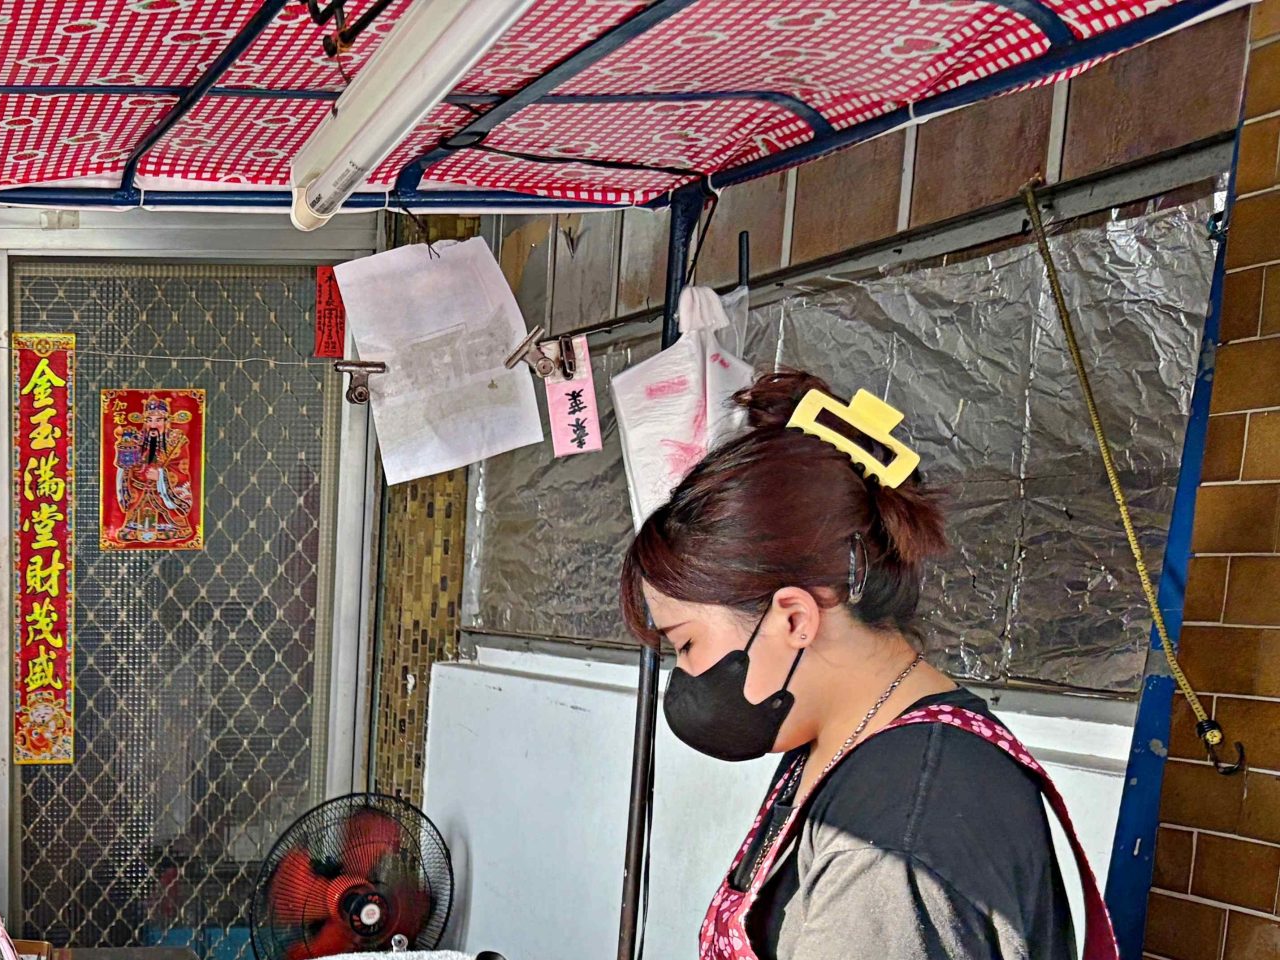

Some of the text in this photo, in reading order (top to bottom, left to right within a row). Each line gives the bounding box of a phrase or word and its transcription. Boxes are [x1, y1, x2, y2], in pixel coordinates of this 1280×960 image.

[21, 357, 66, 691] 金玉滿堂財茂盛
